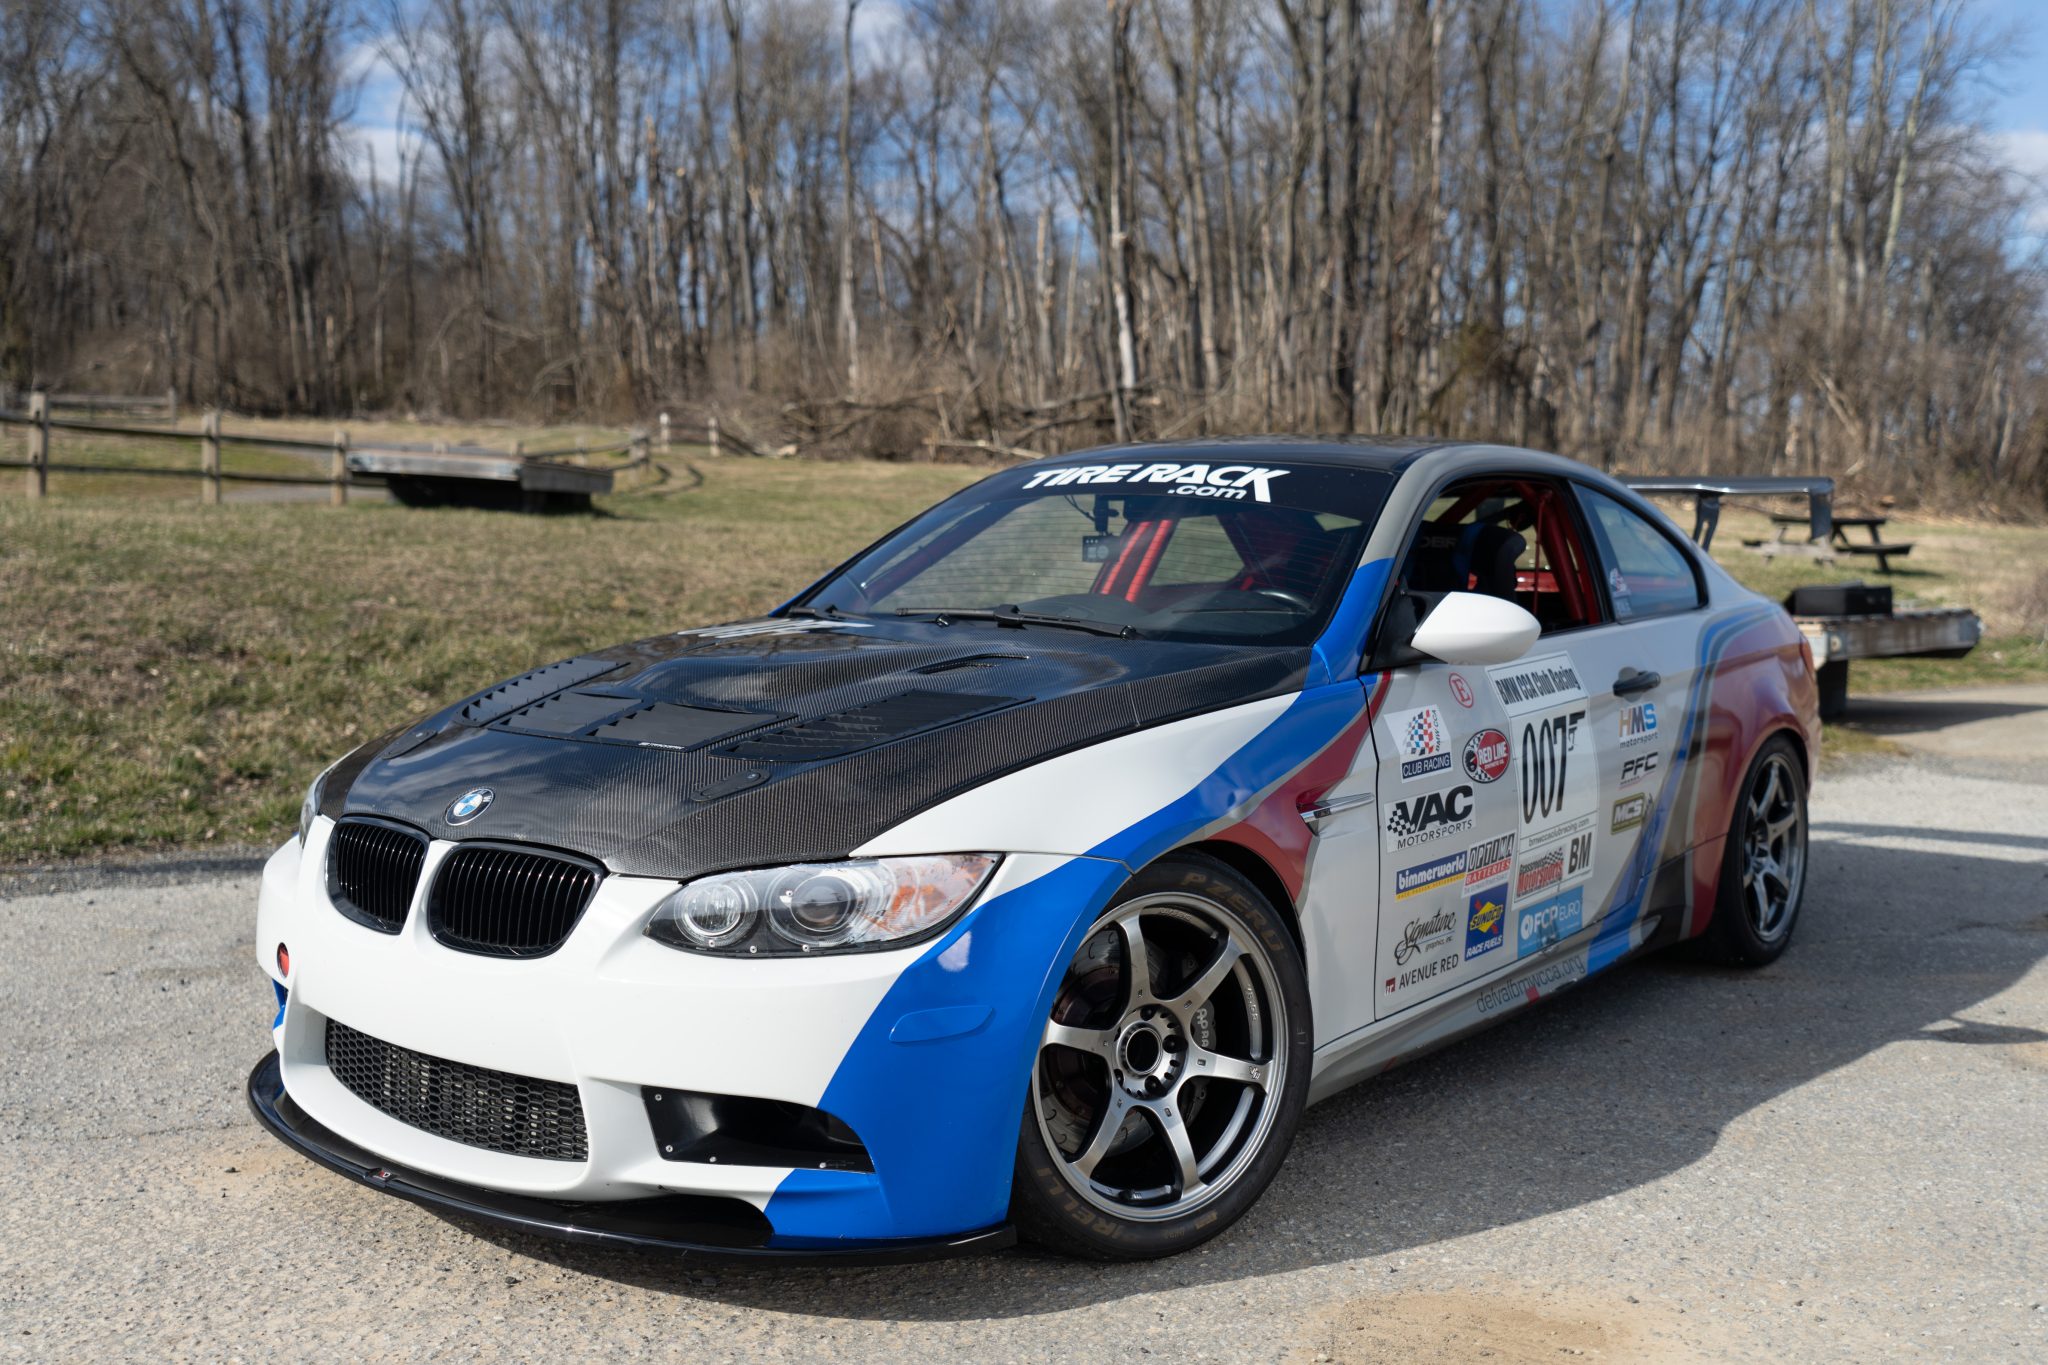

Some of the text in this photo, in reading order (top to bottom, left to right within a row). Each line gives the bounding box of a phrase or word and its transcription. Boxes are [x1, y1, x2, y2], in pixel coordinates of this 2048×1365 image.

[1022, 463, 1291, 503] TIRE RACK
[1167, 485, 1247, 500] .com
[1495, 666, 1581, 705] BMW CCA Club Racing
[1619, 703, 1657, 737] HMS
[1478, 746, 1493, 765] RED
[1492, 741, 1509, 760] LINE
[1619, 732, 1659, 750] motorsport
[1402, 754, 1451, 778] CLUB RACING
[1621, 752, 1659, 780] PFC
[1397, 785, 1473, 834] VAC
[1614, 800, 1643, 823] MCS
[1397, 819, 1473, 849] MOTORSPORTS
[1468, 832, 1516, 872] OPTIMA
[1568, 832, 1592, 874] BM
[1398, 853, 1466, 890] bimmerworld
[1465, 858, 1512, 886] BATTERIES
[1471, 906, 1503, 928] SUNOCO
[1533, 905, 1559, 933] FCP
[1559, 900, 1580, 921] EURO
[1394, 908, 1456, 966] Signature
[1466, 941, 1485, 957] RACE
[1484, 935, 1503, 951] FUELS
[1399, 961, 1437, 990] AVENUE
[1440, 953, 1459, 974] RED
